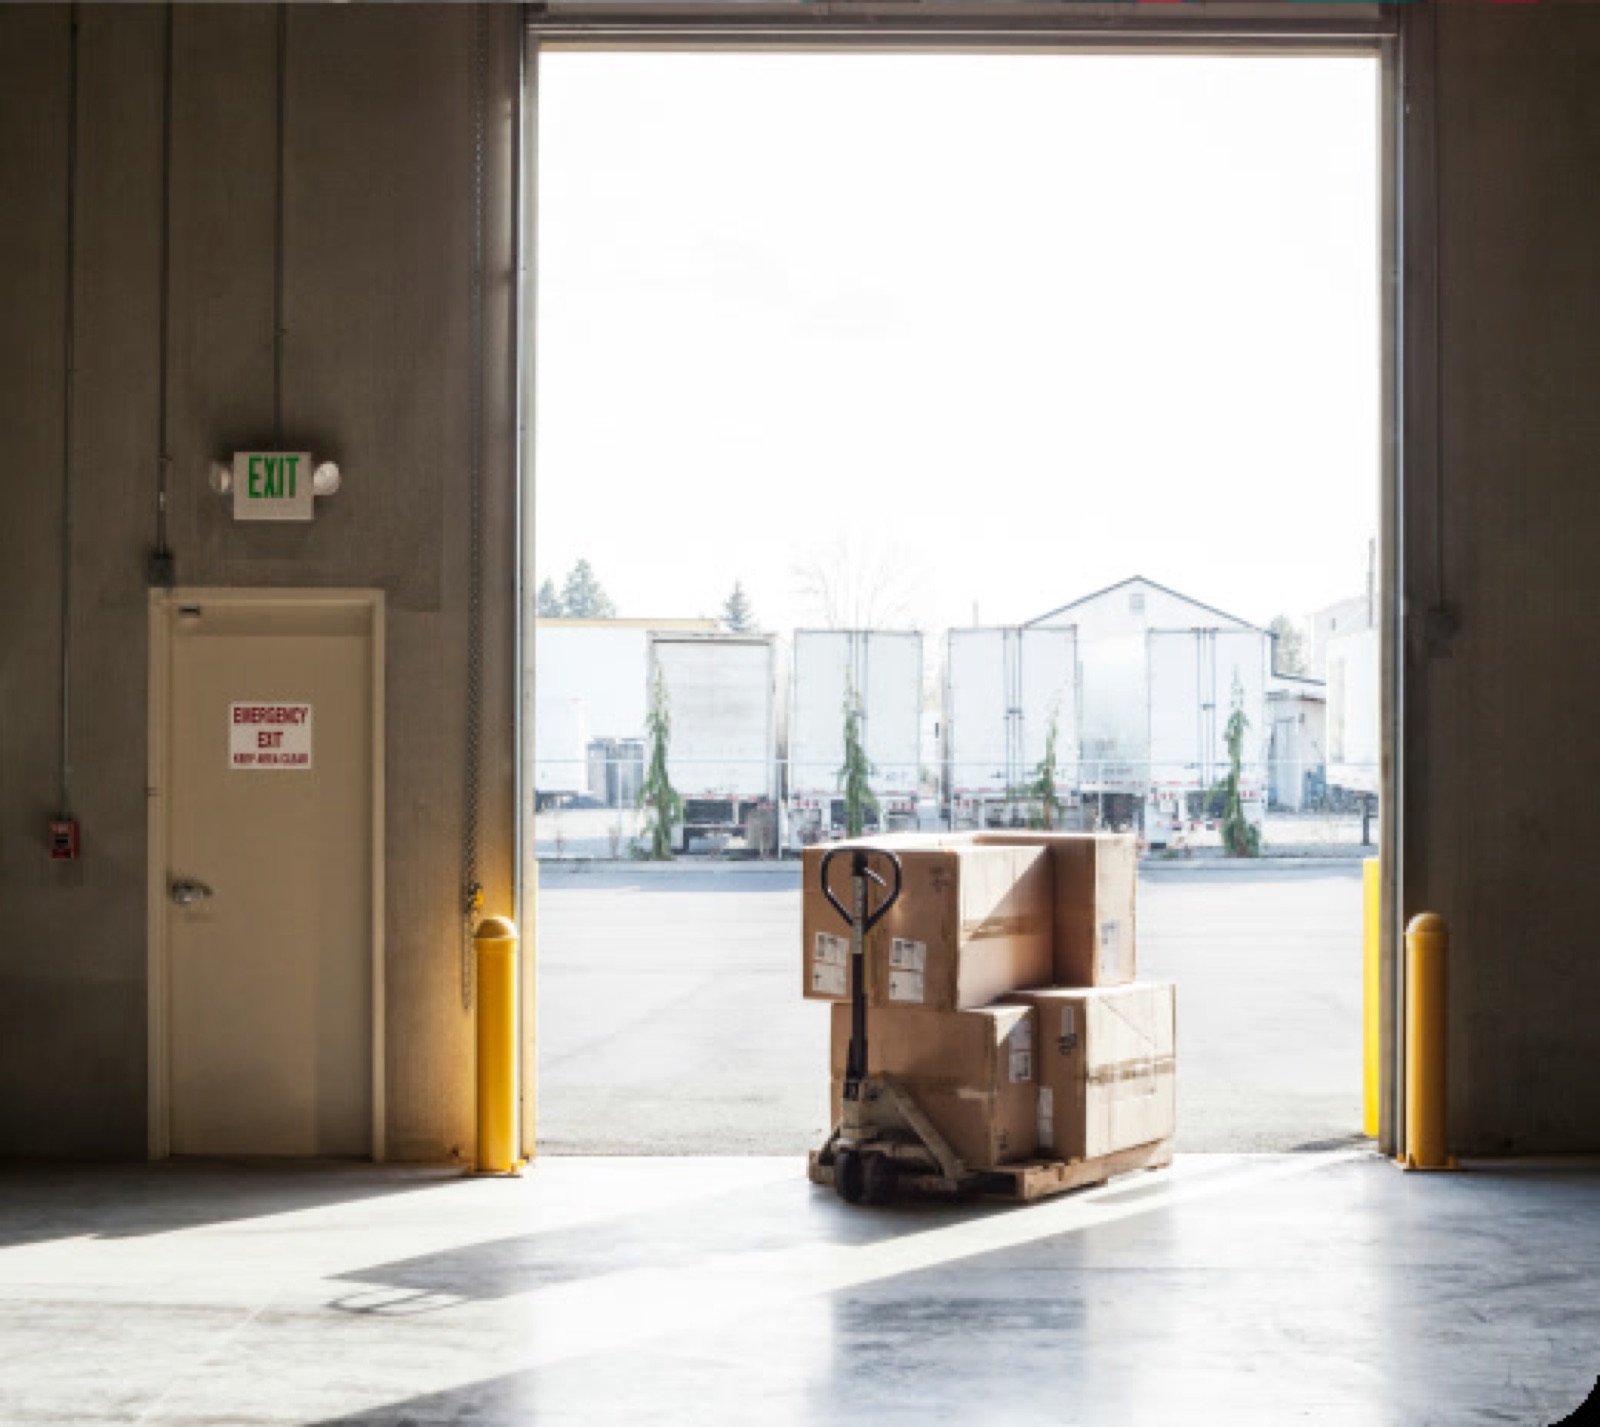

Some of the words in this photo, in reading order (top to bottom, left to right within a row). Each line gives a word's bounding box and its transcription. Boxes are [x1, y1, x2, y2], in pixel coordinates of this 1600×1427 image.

[248, 456, 301, 499] EXIT
[233, 706, 308, 724] EMERGENCY
[257, 731, 284, 748] EXIT
